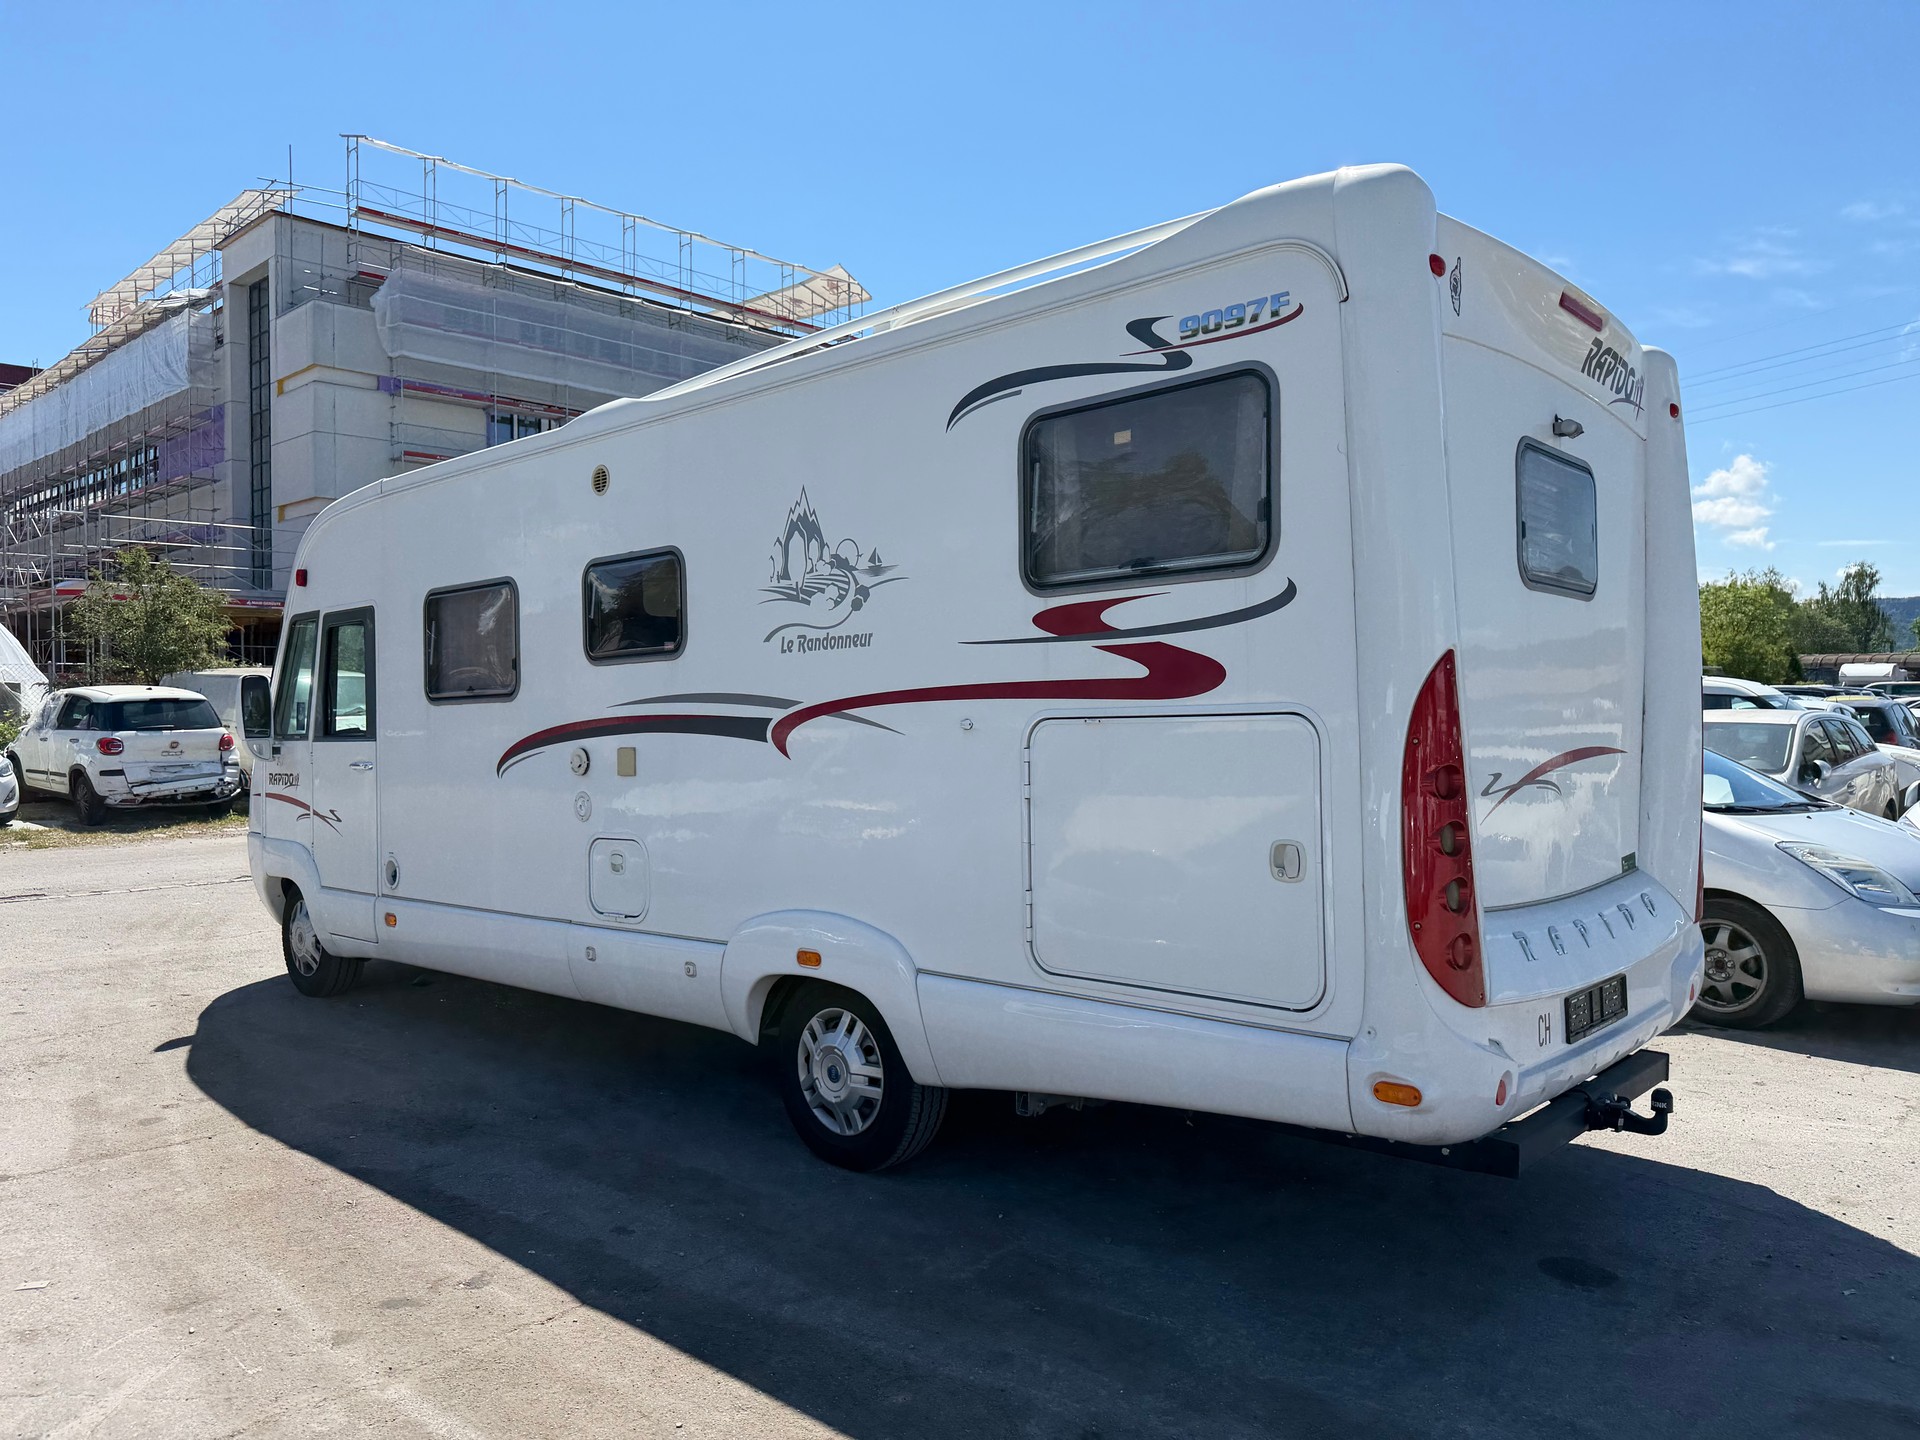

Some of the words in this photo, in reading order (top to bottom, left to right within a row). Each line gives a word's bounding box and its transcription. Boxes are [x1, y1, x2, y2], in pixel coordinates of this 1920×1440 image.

[1178, 291, 1290, 341] 9097F
[1580, 336, 1636, 400] RAPIDO
[780, 636, 794, 654] Le
[797, 632, 873, 654] Randonneur
[268, 772, 295, 786] RAPIDO
[1512, 892, 1657, 962] RAPIDO
[1538, 1012, 1552, 1047] CH
